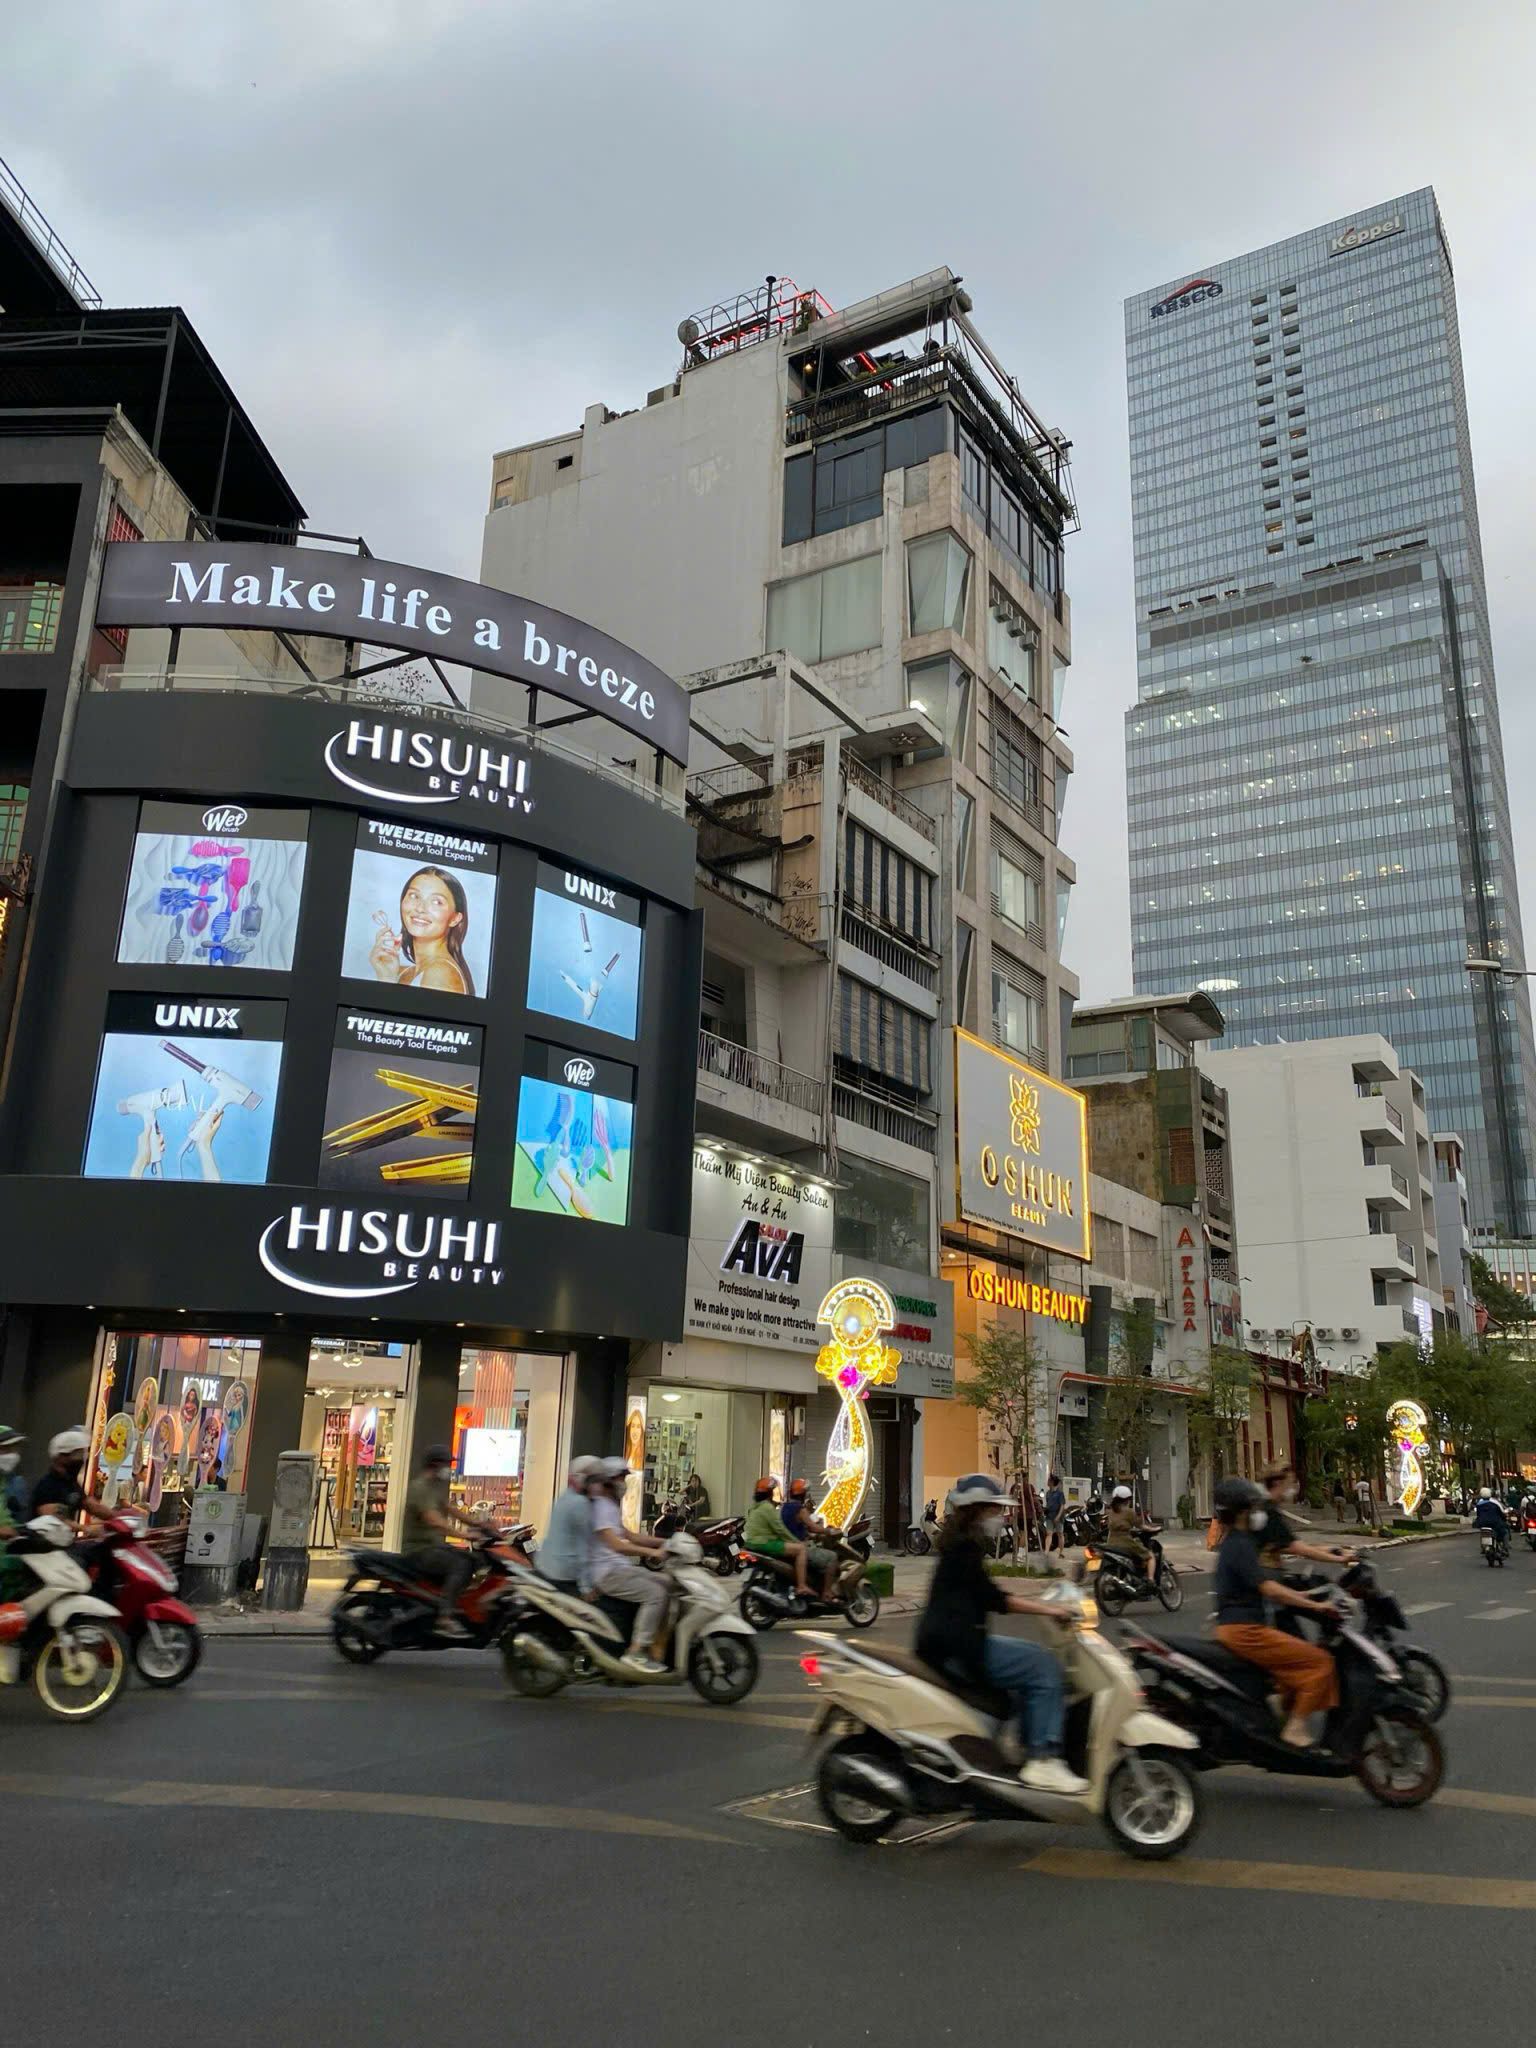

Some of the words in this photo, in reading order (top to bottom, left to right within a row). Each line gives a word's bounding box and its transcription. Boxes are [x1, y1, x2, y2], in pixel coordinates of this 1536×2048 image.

[1331, 215, 1401, 251] Keppel
[165, 562, 336, 613] Make
[357, 577, 452, 635] life
[473, 618, 502, 651] a
[523, 619, 656, 720] breeze
[346, 720, 527, 794] HISUHI
[428, 775, 533, 814] BEAUTY
[206, 808, 244, 832] Wet
[378, 835, 394, 847] The
[395, 840, 424, 854] Beauty
[426, 844, 443, 856] Tool
[444, 848, 475, 863] Experts
[564, 871, 617, 909] UNIX
[155, 1004, 241, 1029] UNIX
[357, 1031, 373, 1043] The
[375, 1034, 406, 1049] Beauty
[407, 1038, 425, 1050] Tool
[426, 1041, 458, 1054] Experts
[567, 1062, 592, 1085] Wet
[768, 1175, 802, 1204] Beauty
[802, 1186, 829, 1209] Salon
[981, 1145, 1074, 1218] OSHUN
[760, 1197, 770, 1216] &
[1010, 1202, 1047, 1227] BEAUTY
[287, 1206, 497, 1264] HISUHI
[720, 1218, 805, 1285] AVA
[1177, 1226, 1195, 1248] A
[383, 1261, 503, 1285] BEAUTY
[718, 1280, 764, 1301] Professional
[764, 1289, 778, 1304] hair
[778, 1291, 800, 1310] design
[970, 1269, 1028, 1311] OSHUN
[1031, 1284, 1086, 1324] BEAUTY
[1180, 1256, 1197, 1332] PLAZA
[694, 1298, 707, 1313] We
[708, 1302, 729, 1317] make
[731, 1308, 745, 1321] you
[746, 1307, 762, 1322] look
[763, 1313, 781, 1327] more
[782, 1316, 817, 1332] attractive
